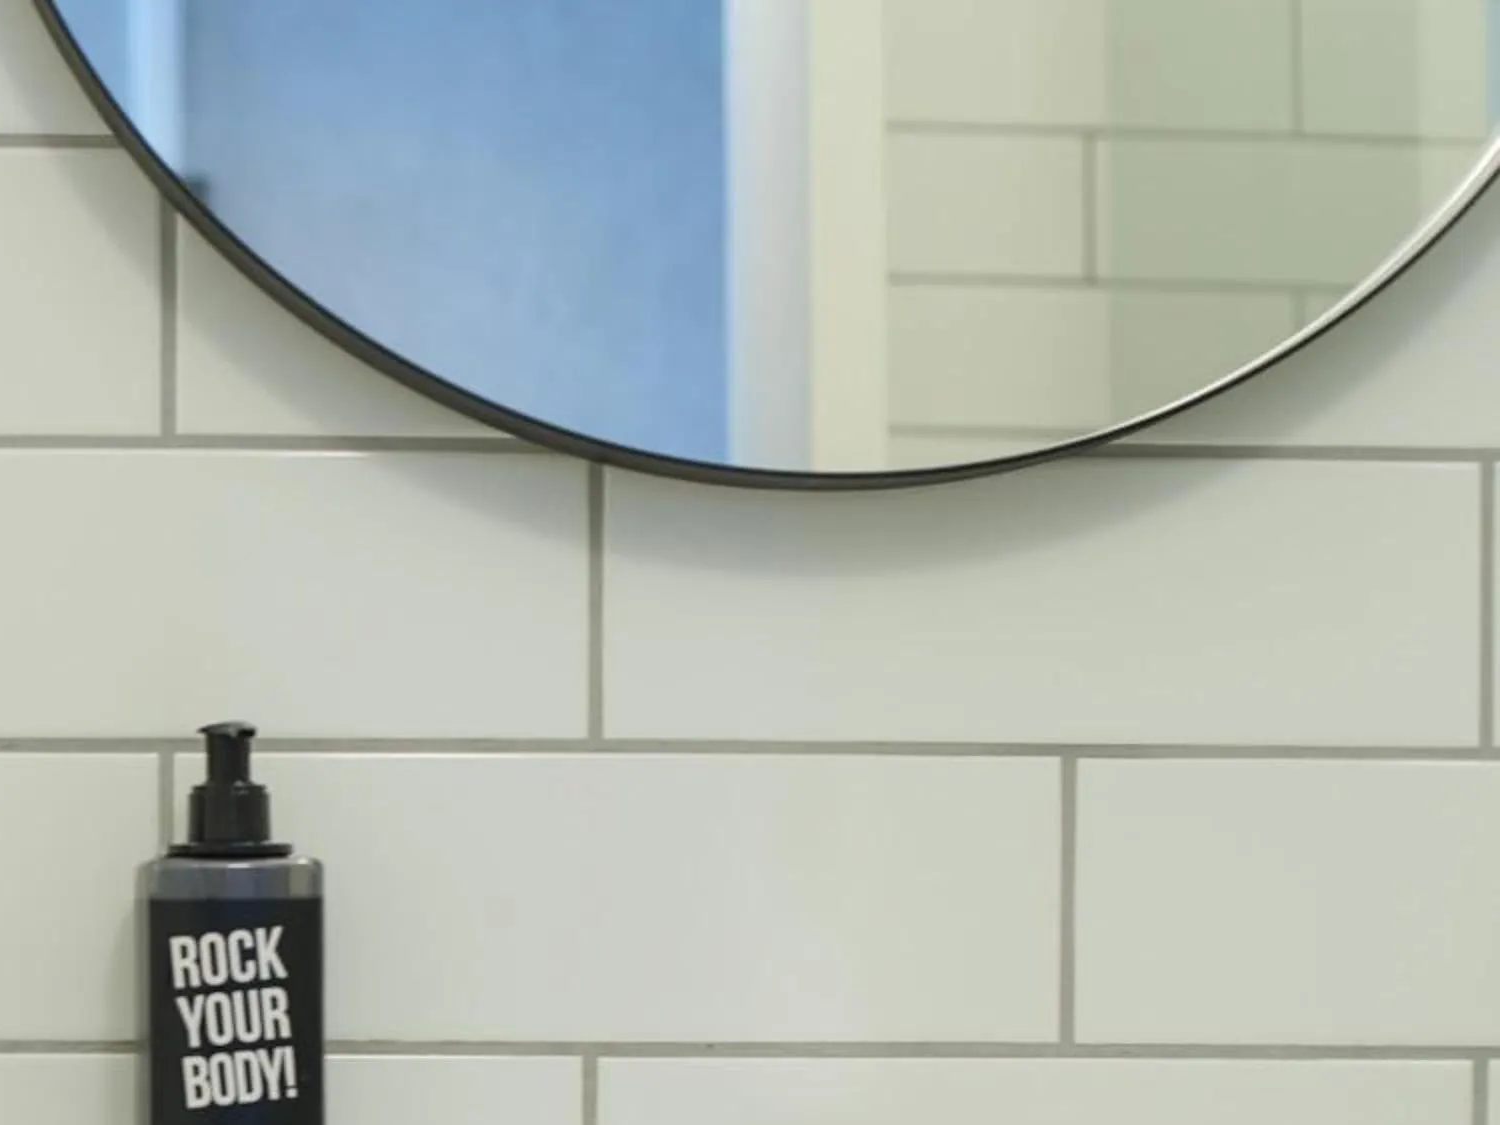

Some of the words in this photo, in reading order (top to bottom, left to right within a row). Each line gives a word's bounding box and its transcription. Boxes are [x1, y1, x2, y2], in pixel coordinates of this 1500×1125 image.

[169, 926, 288, 989] ROCK
[175, 986, 292, 1048] YOUR
[181, 1046, 299, 1109] BODY!
